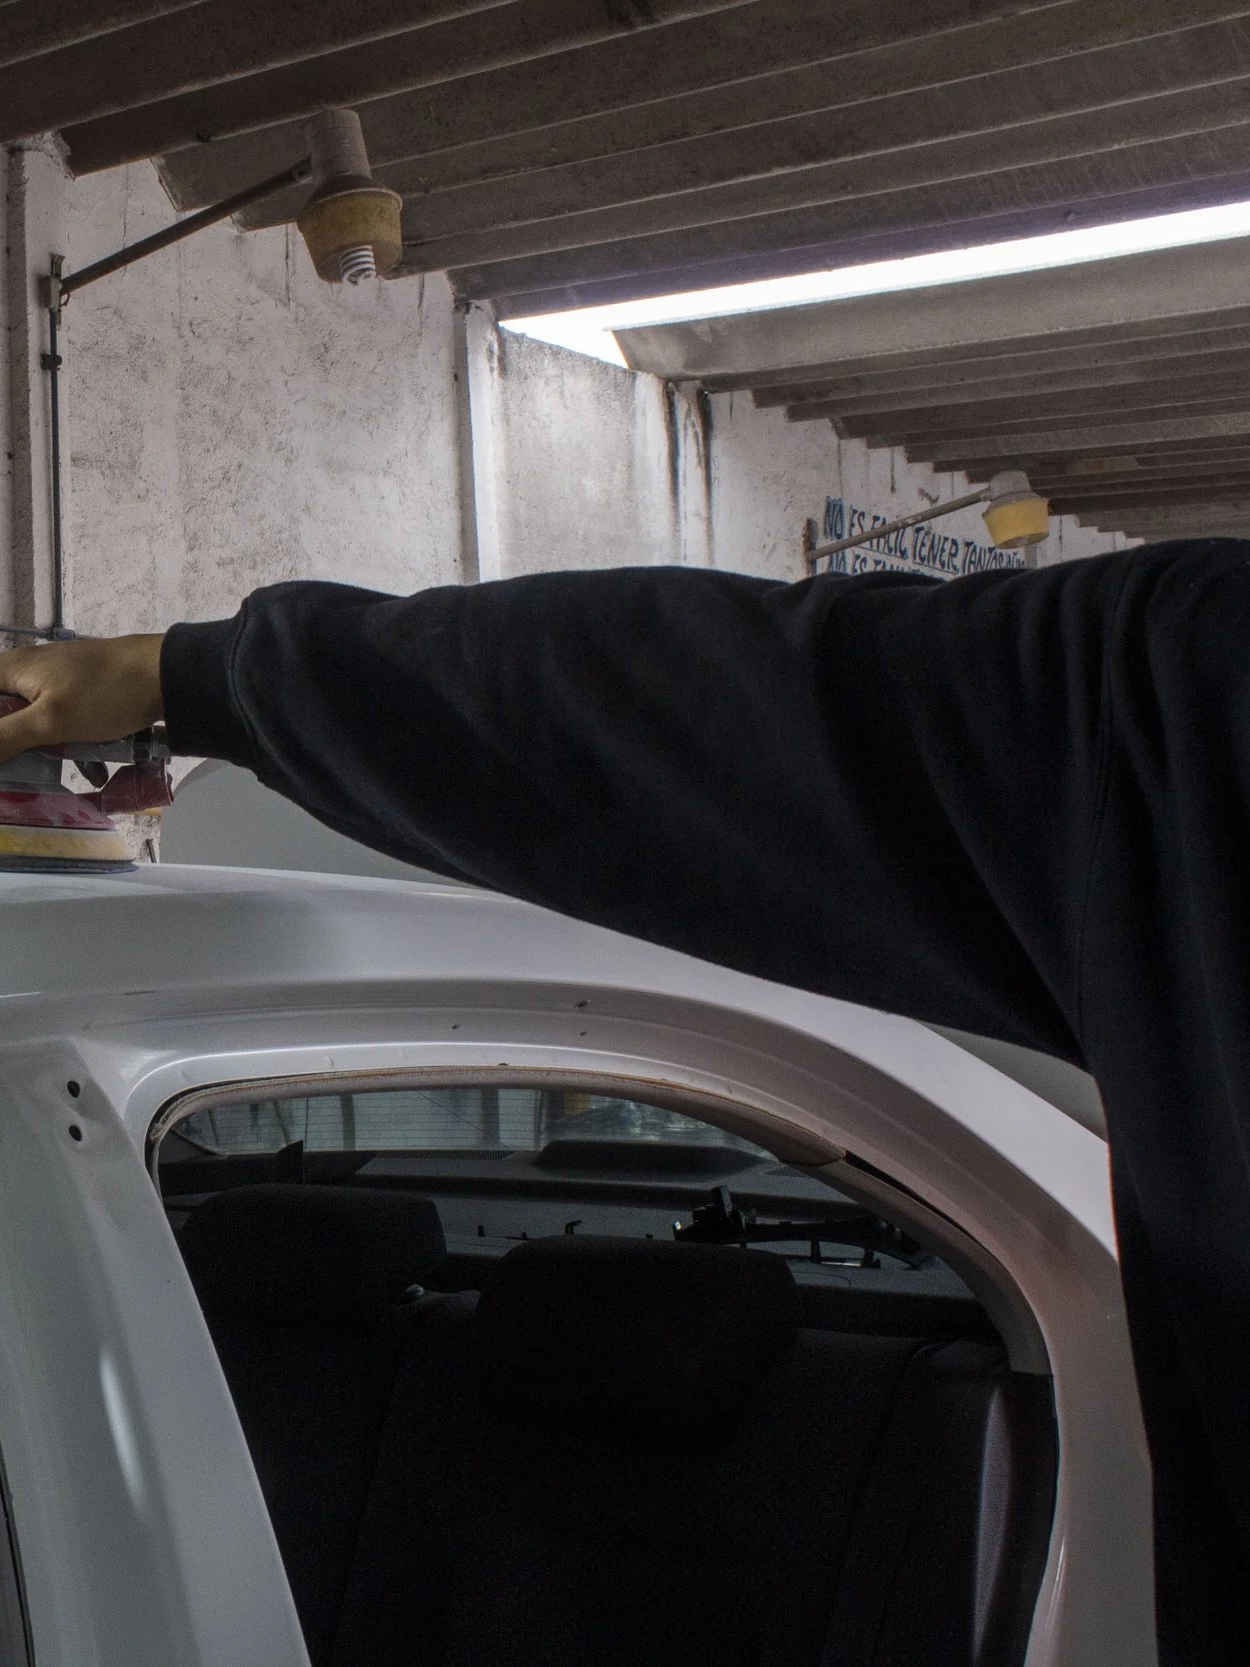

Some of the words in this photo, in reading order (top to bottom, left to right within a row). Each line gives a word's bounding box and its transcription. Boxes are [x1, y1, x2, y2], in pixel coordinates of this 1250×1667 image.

[823, 495, 847, 539] NO
[849, 505, 866, 538] ES
[912, 526, 960, 574] TENER
